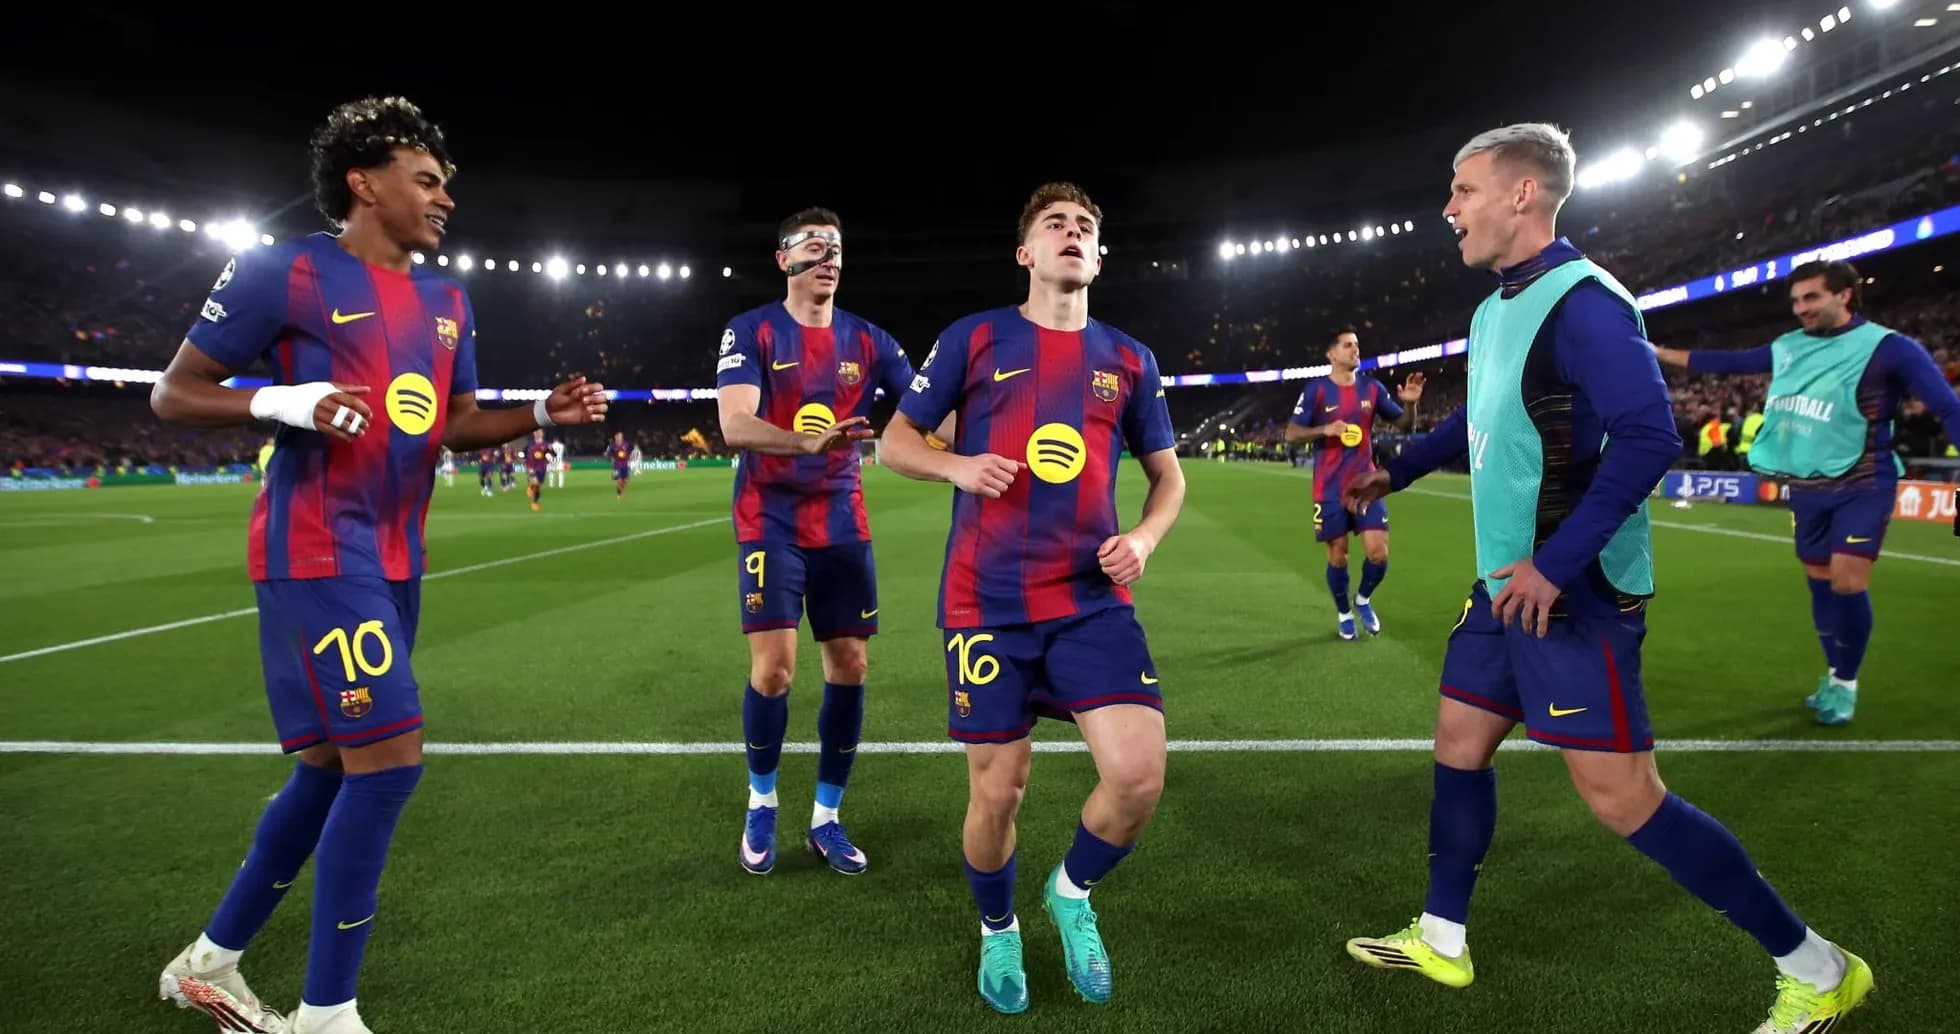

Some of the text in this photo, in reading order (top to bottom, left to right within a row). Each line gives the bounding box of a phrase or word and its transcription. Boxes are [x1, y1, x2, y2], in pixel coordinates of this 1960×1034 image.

[176, 471, 240, 486] Heineken
[1697, 477, 1740, 498] PS5
[1927, 489, 1957, 519] JU
[744, 551, 766, 588] 9
[313, 620, 393, 682] 10
[947, 633, 1000, 685] 16
